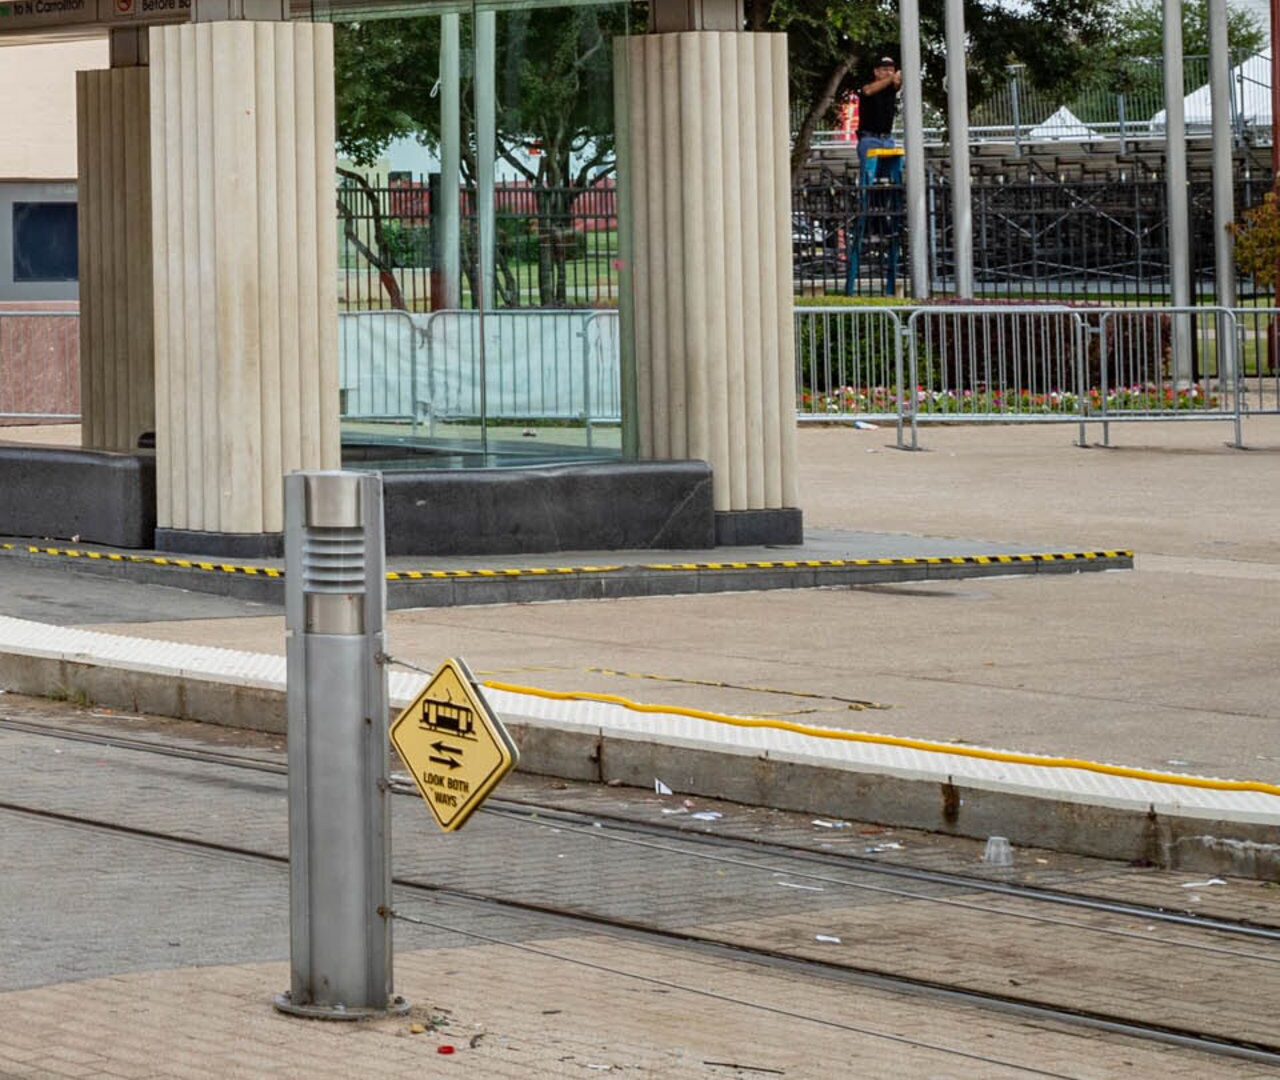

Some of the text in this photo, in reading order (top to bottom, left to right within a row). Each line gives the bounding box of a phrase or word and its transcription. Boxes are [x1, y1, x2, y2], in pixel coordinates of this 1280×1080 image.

[13, 3, 23, 16] to
[25, 1, 33, 14] N
[423, 771, 470, 793] LOOK BOTH
[434, 791, 458, 808] WAYS
